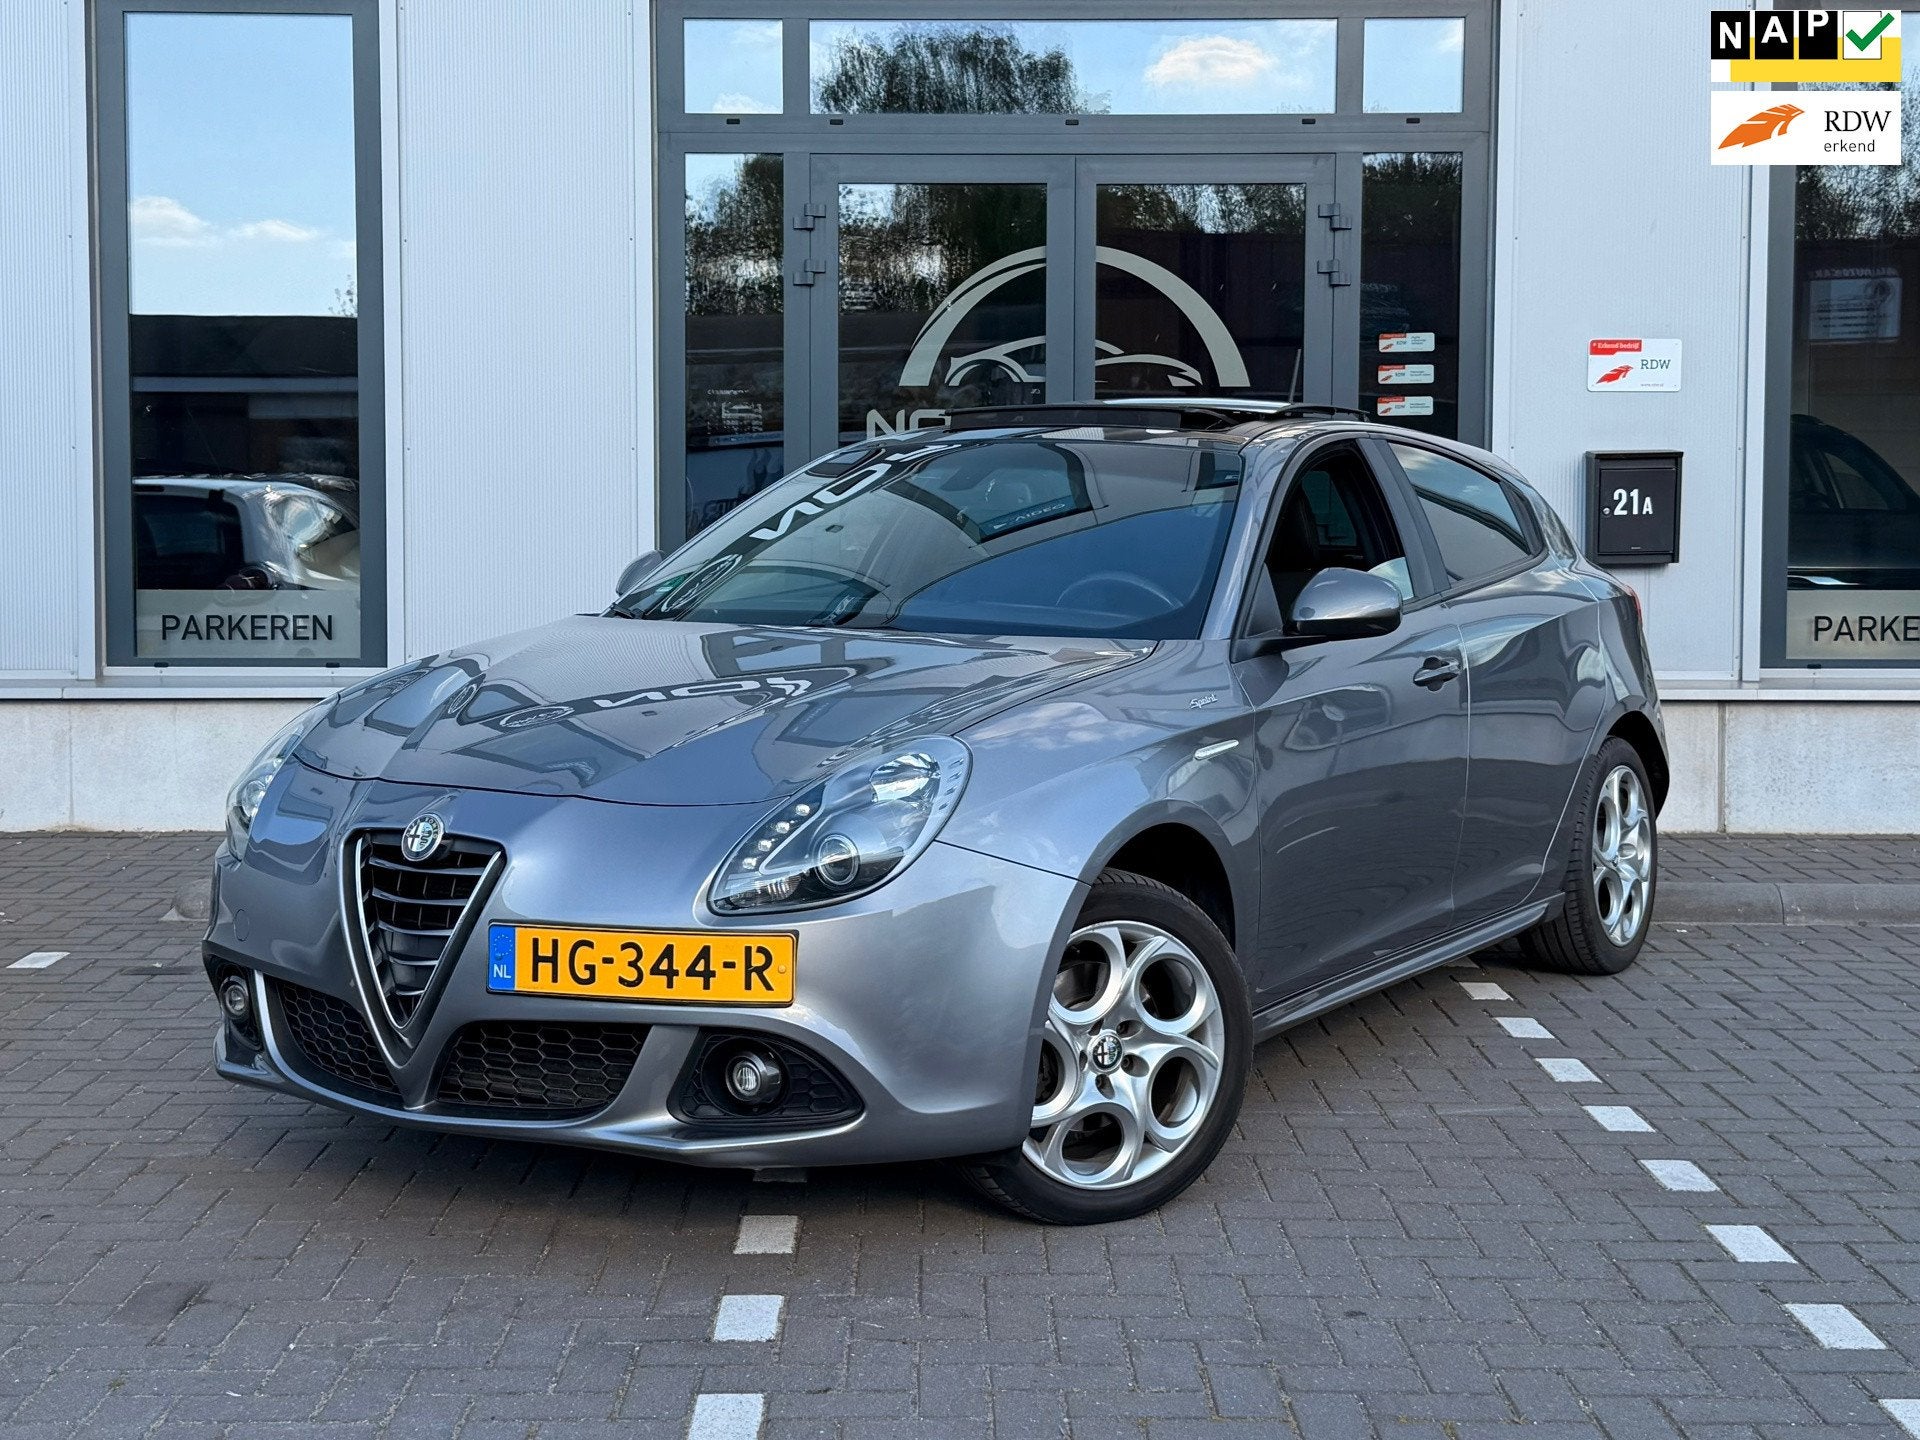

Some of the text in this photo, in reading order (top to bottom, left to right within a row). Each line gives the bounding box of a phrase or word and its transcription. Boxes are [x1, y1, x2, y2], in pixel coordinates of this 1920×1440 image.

[1640, 359, 1671, 370] RDW
[1613, 488, 1653, 516] 21A
[161, 614, 333, 641] PARKEREN
[1813, 615, 1920, 642] PARKE
[492, 963, 512, 979] NL
[531, 936, 775, 992] HG-344-R
